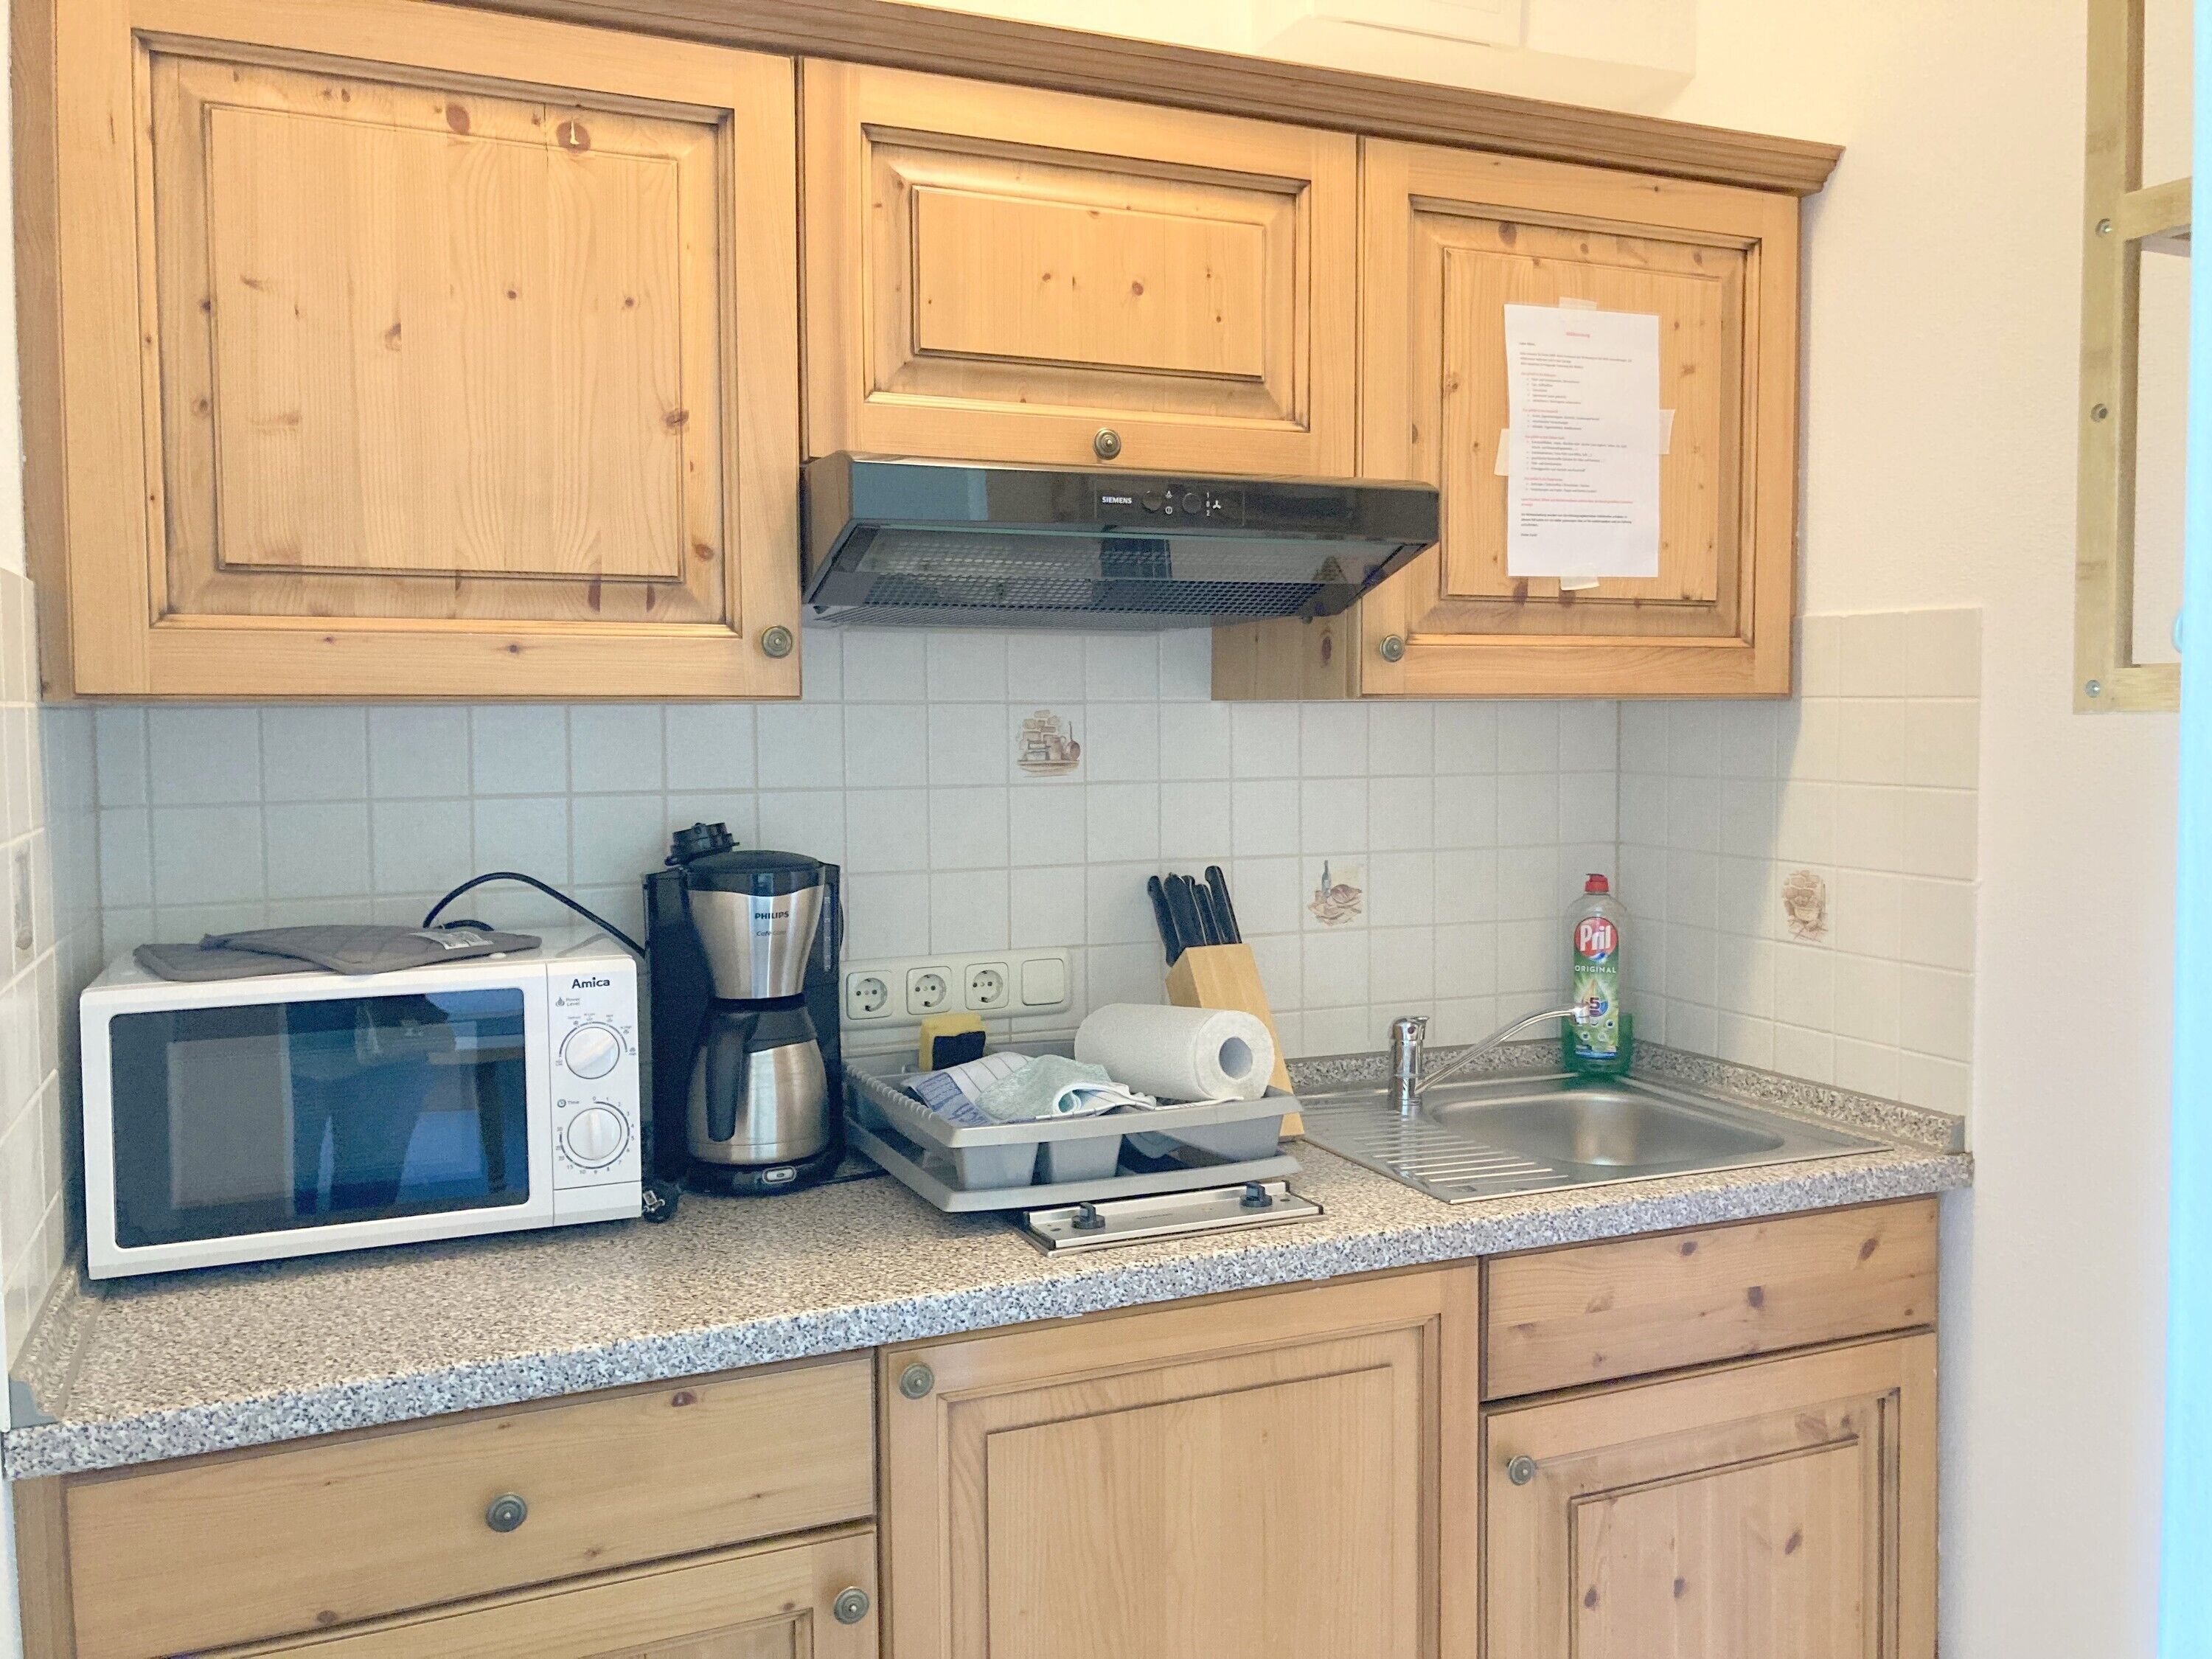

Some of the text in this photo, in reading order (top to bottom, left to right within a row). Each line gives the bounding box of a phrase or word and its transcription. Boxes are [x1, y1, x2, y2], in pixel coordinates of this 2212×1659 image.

[1102, 495, 1133, 504] SIEMENS
[754, 911, 789, 919] PHILIPS
[1579, 925, 1612, 952] Pril
[1575, 964, 1616, 973] ORIGINAL
[571, 977, 611, 989] Amica
[1589, 997, 1601, 1010] 5
